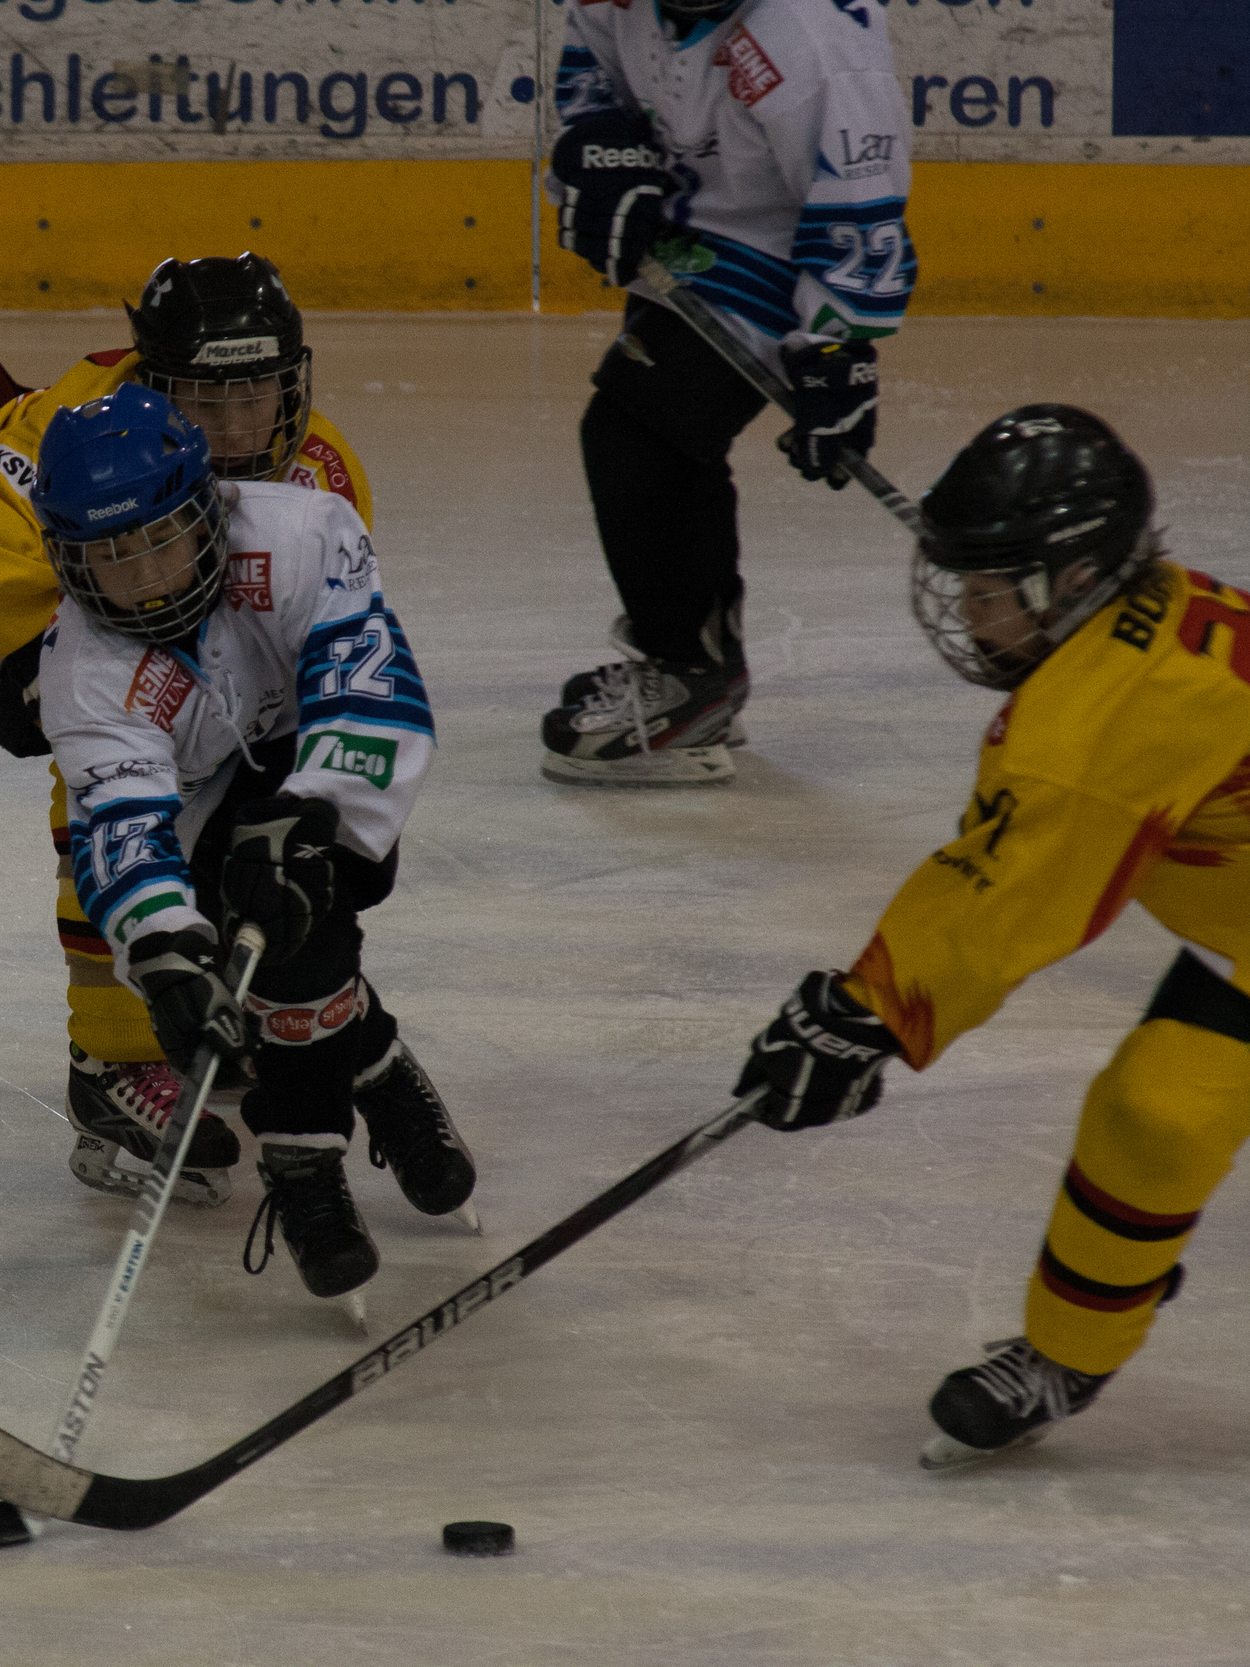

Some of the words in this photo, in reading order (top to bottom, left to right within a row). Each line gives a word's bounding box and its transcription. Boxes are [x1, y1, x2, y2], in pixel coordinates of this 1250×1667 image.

[824, 221, 908, 298] 22
[206, 341, 263, 358] Marcel
[307, 444, 350, 489] ASKÖ
[87, 497, 140, 522] Reebok
[320, 613, 396, 701] 12
[84, 811, 165, 894] 12
[351, 1255, 525, 1393] BAUER
